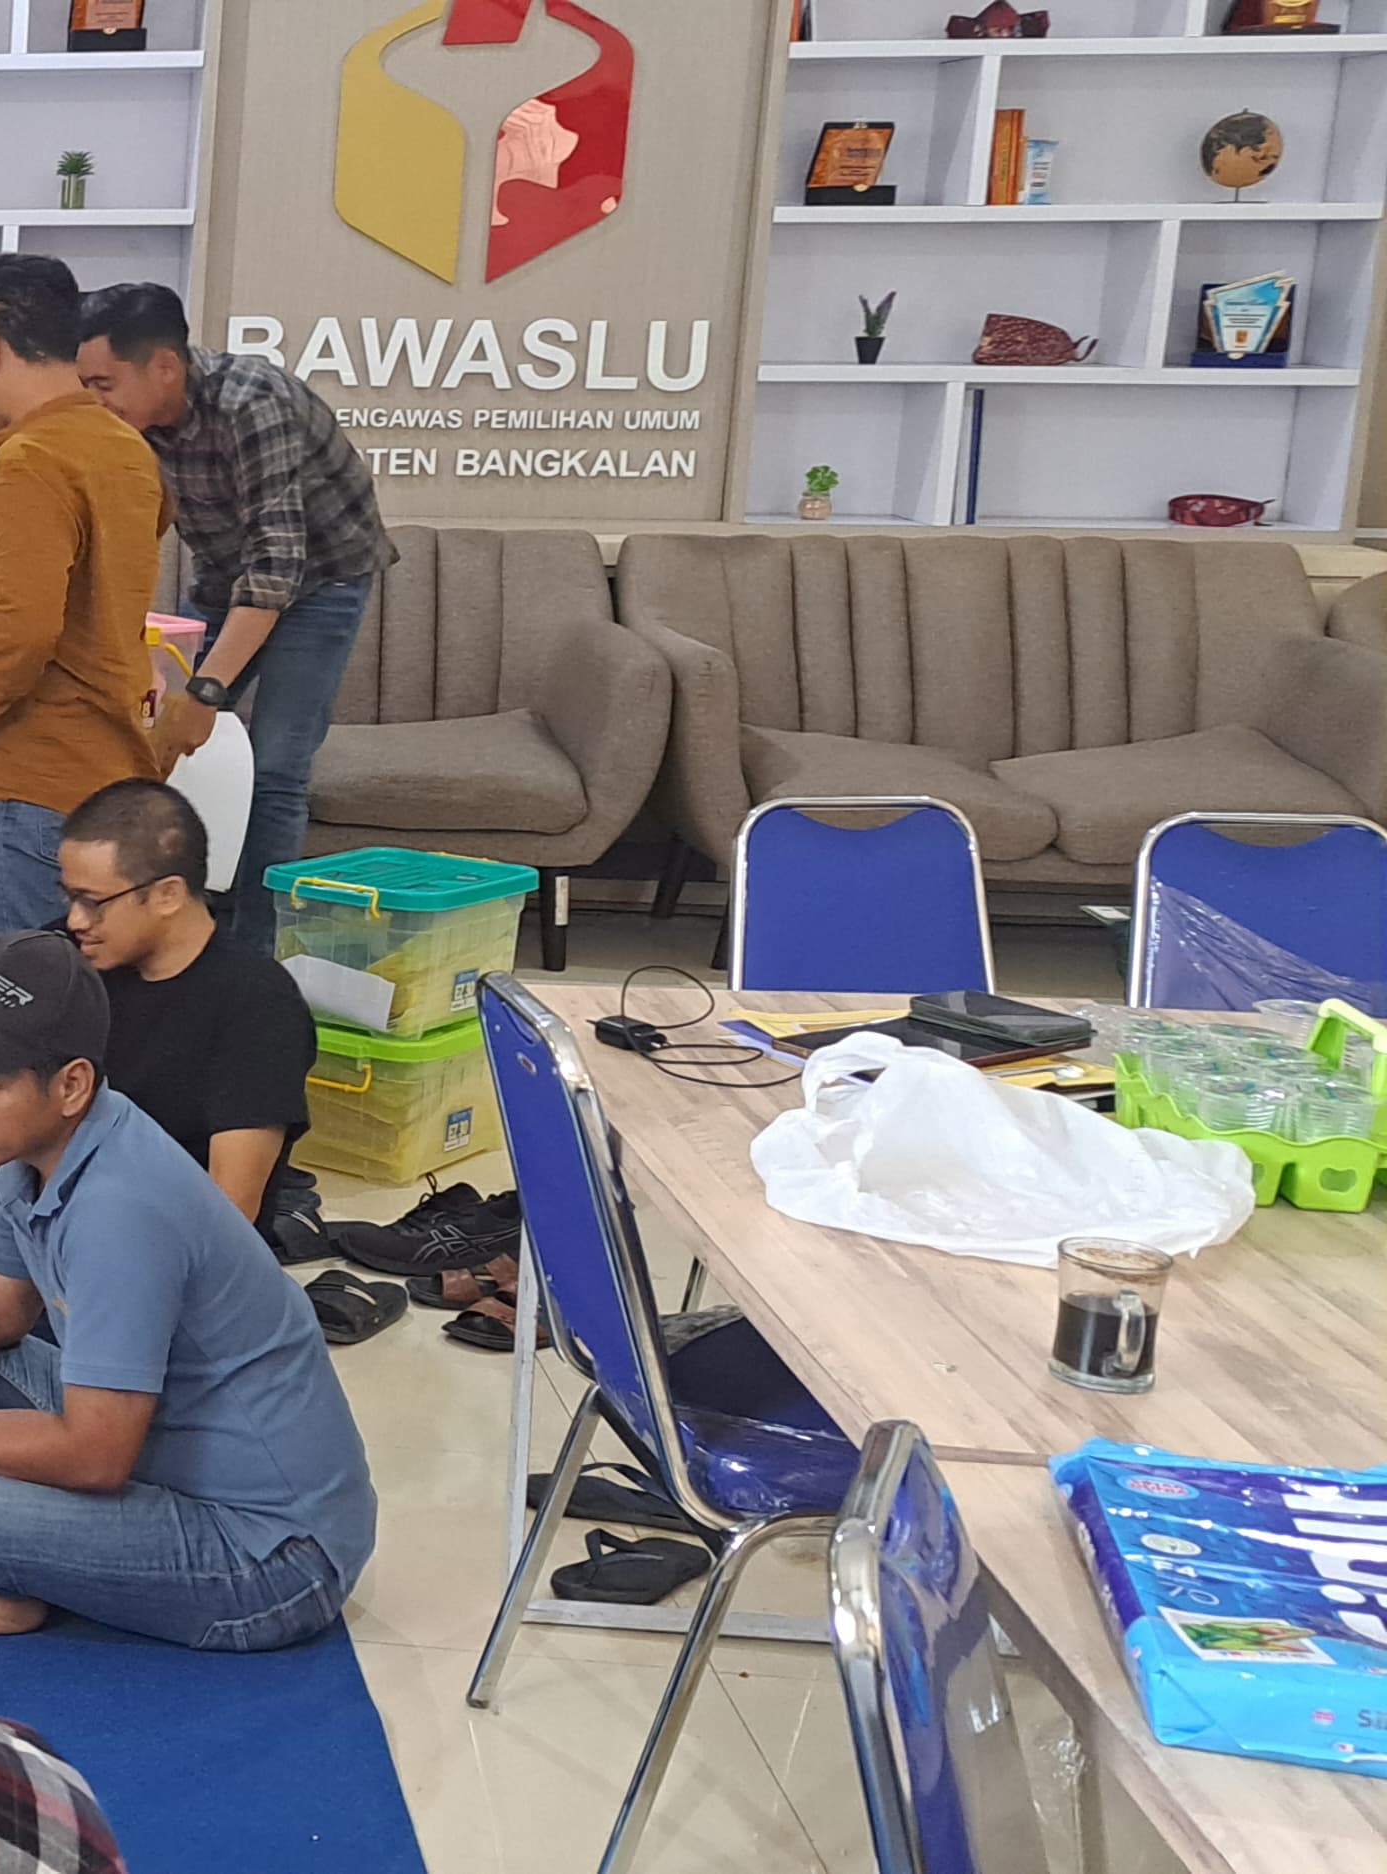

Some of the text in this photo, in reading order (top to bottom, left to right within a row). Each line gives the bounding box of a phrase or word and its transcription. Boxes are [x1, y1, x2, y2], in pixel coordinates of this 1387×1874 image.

[337, 407, 701, 430] ENGAWAS PEMILIHAN UMUM
[360, 447, 696, 478] TEN BANGKALAN
